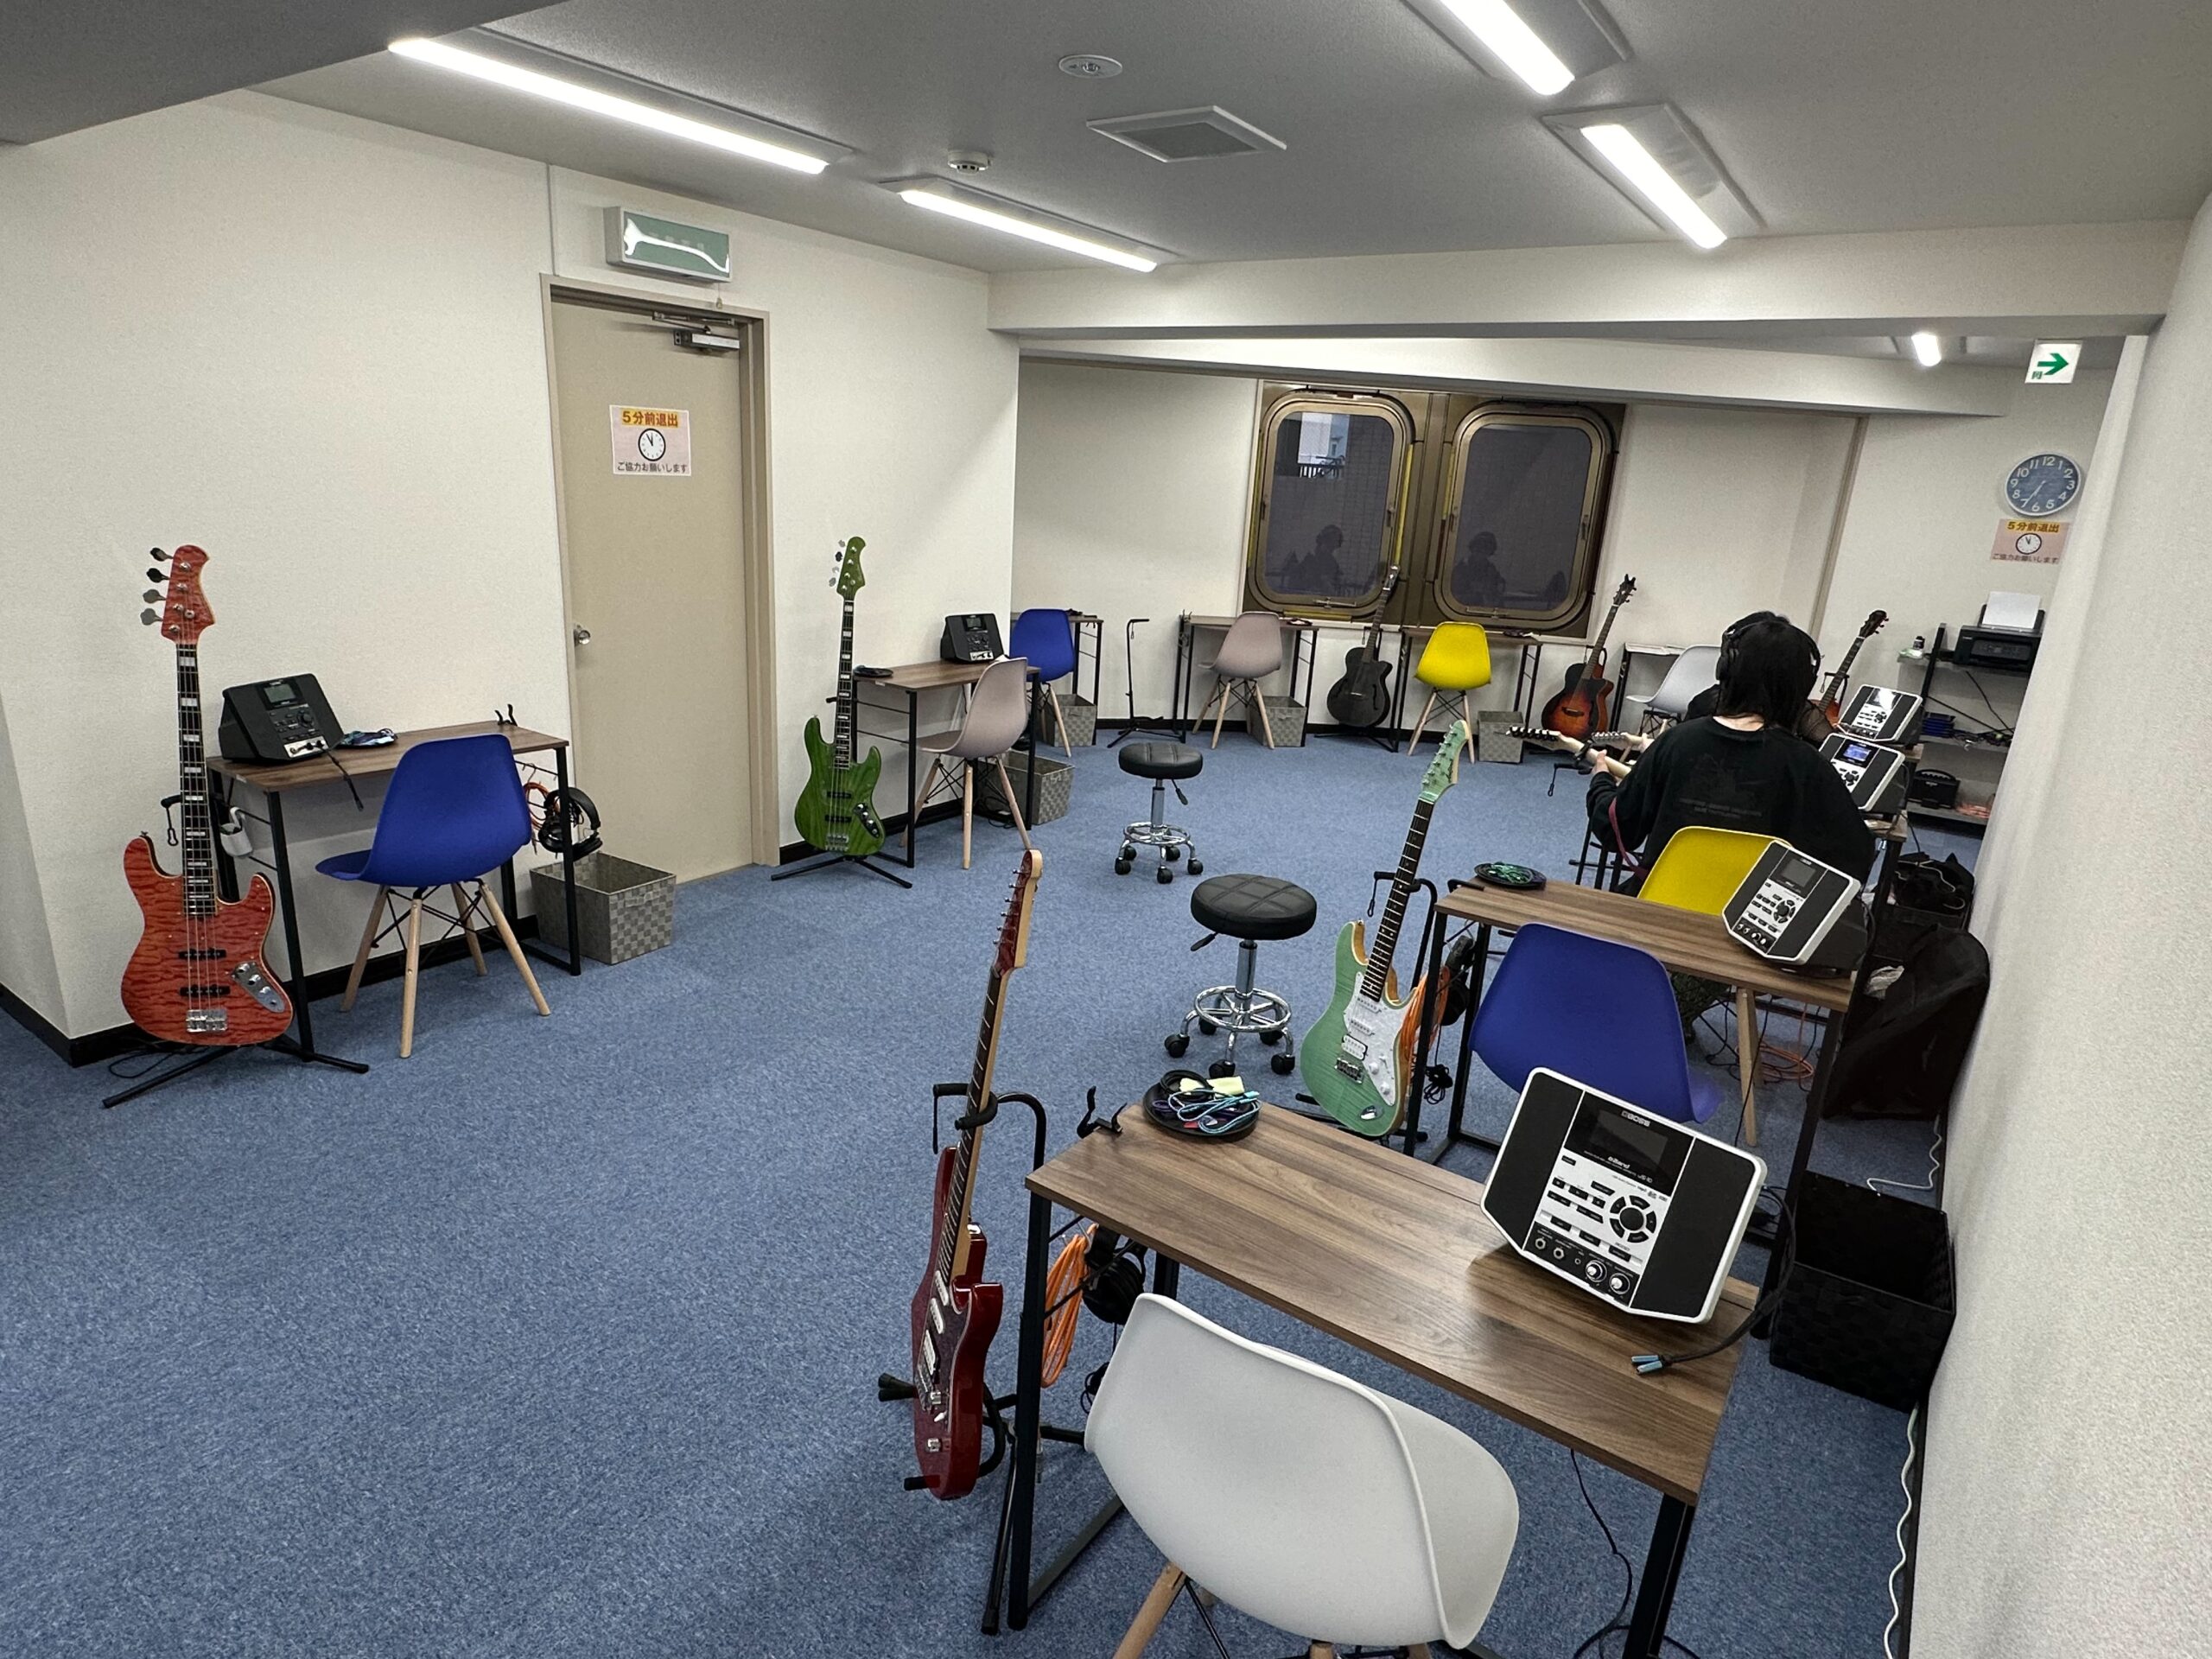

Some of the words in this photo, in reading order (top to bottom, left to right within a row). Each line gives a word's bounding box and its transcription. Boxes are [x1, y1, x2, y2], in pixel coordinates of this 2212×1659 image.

[2030, 459, 2039, 469] 11
[2042, 456, 2055, 466] 12
[2058, 461, 2063, 470] 1
[617, 462, 688, 473] ご協力お願いします
[2017, 467, 2029, 477] 10
[2063, 469, 2073, 478] 2
[2010, 479, 2018, 488] 9
[2066, 480, 2075, 490] 3
[2012, 489, 2020, 499] 8
[2058, 491, 2067, 500] 4
[2031, 502, 2040, 512] 6
[2045, 499, 2055, 509] 5
[1627, 1113, 1650, 1127] BOSS
